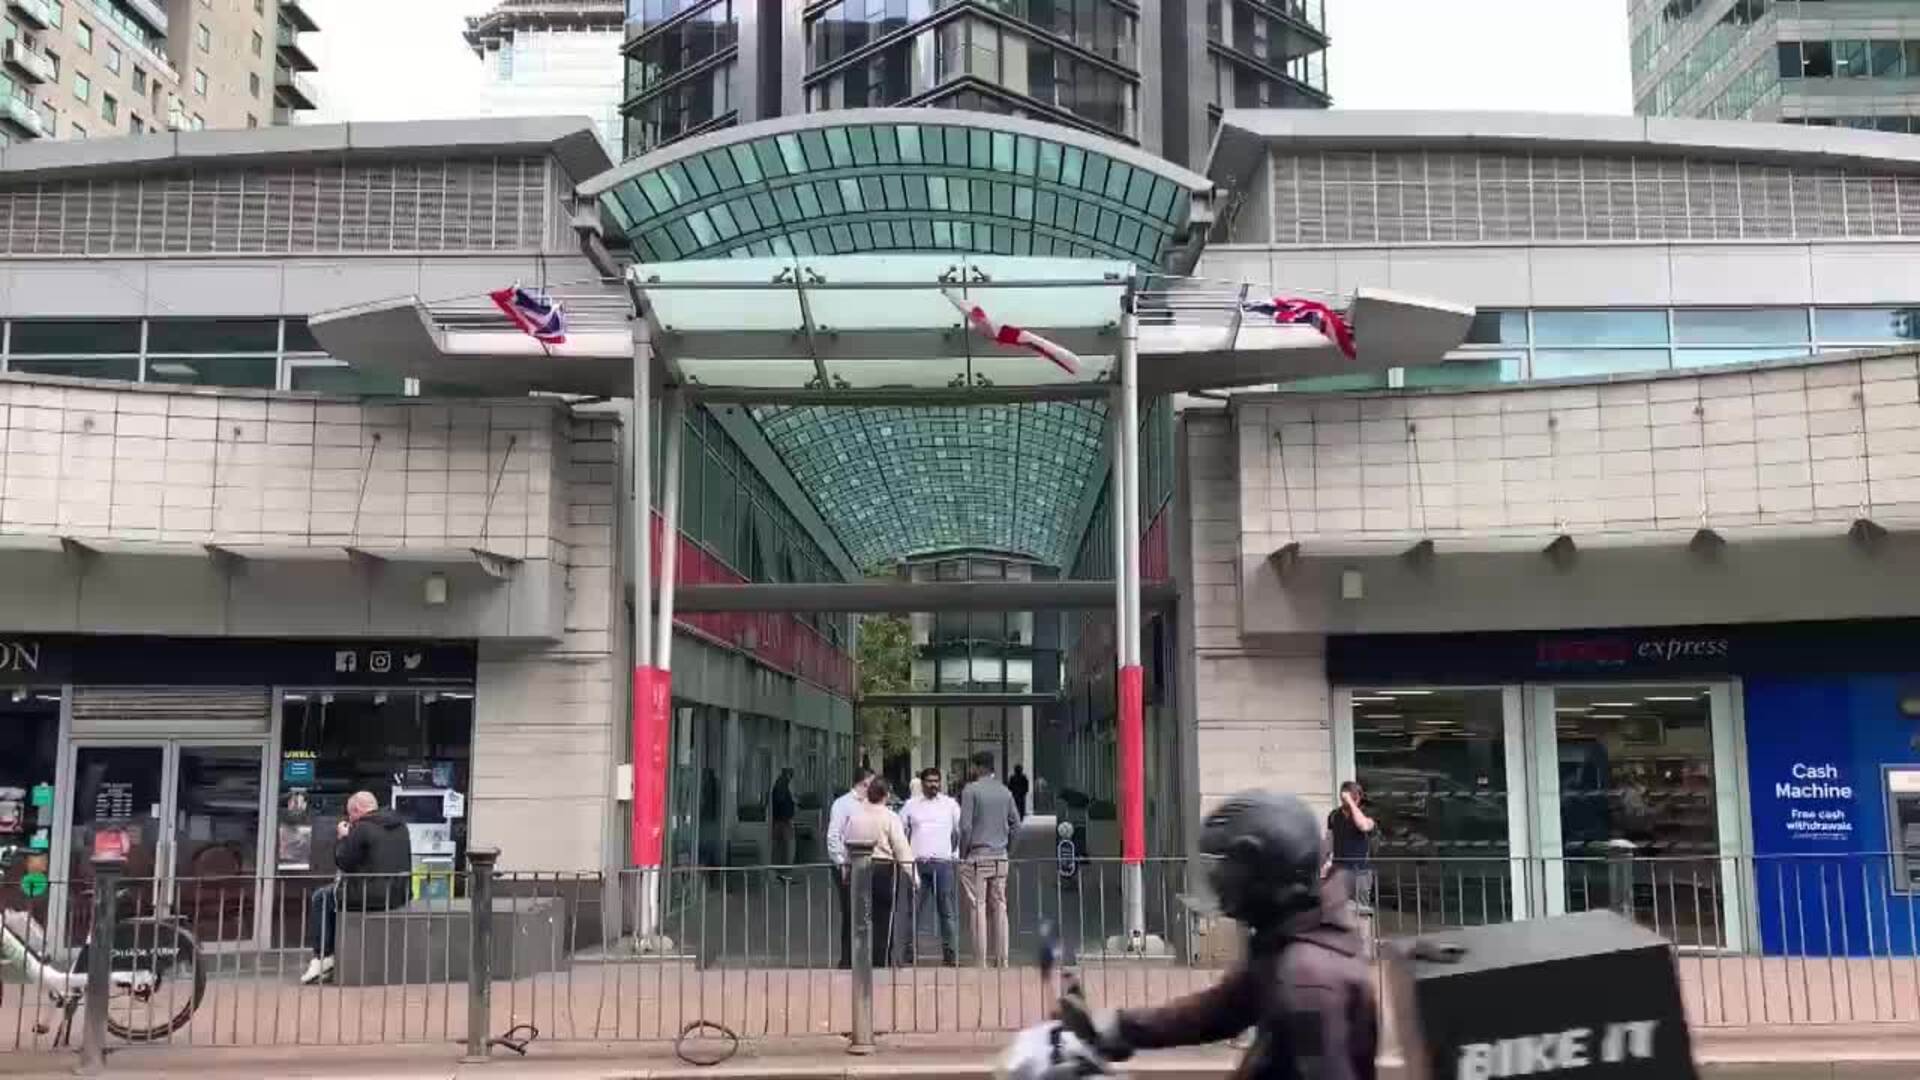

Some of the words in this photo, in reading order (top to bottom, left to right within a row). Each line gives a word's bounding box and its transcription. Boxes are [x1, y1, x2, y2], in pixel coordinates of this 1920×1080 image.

[1636, 638, 1729, 661] express
[1792, 763, 1838, 779] Cash
[1776, 782, 1852, 799] Machine
[1791, 808, 1816, 819] Free
[1818, 809, 1846, 819] cash
[1785, 821, 1853, 831] withdrawals
[1456, 1027, 1593, 1080] BIKE
[1600, 1019, 1661, 1063] IT
